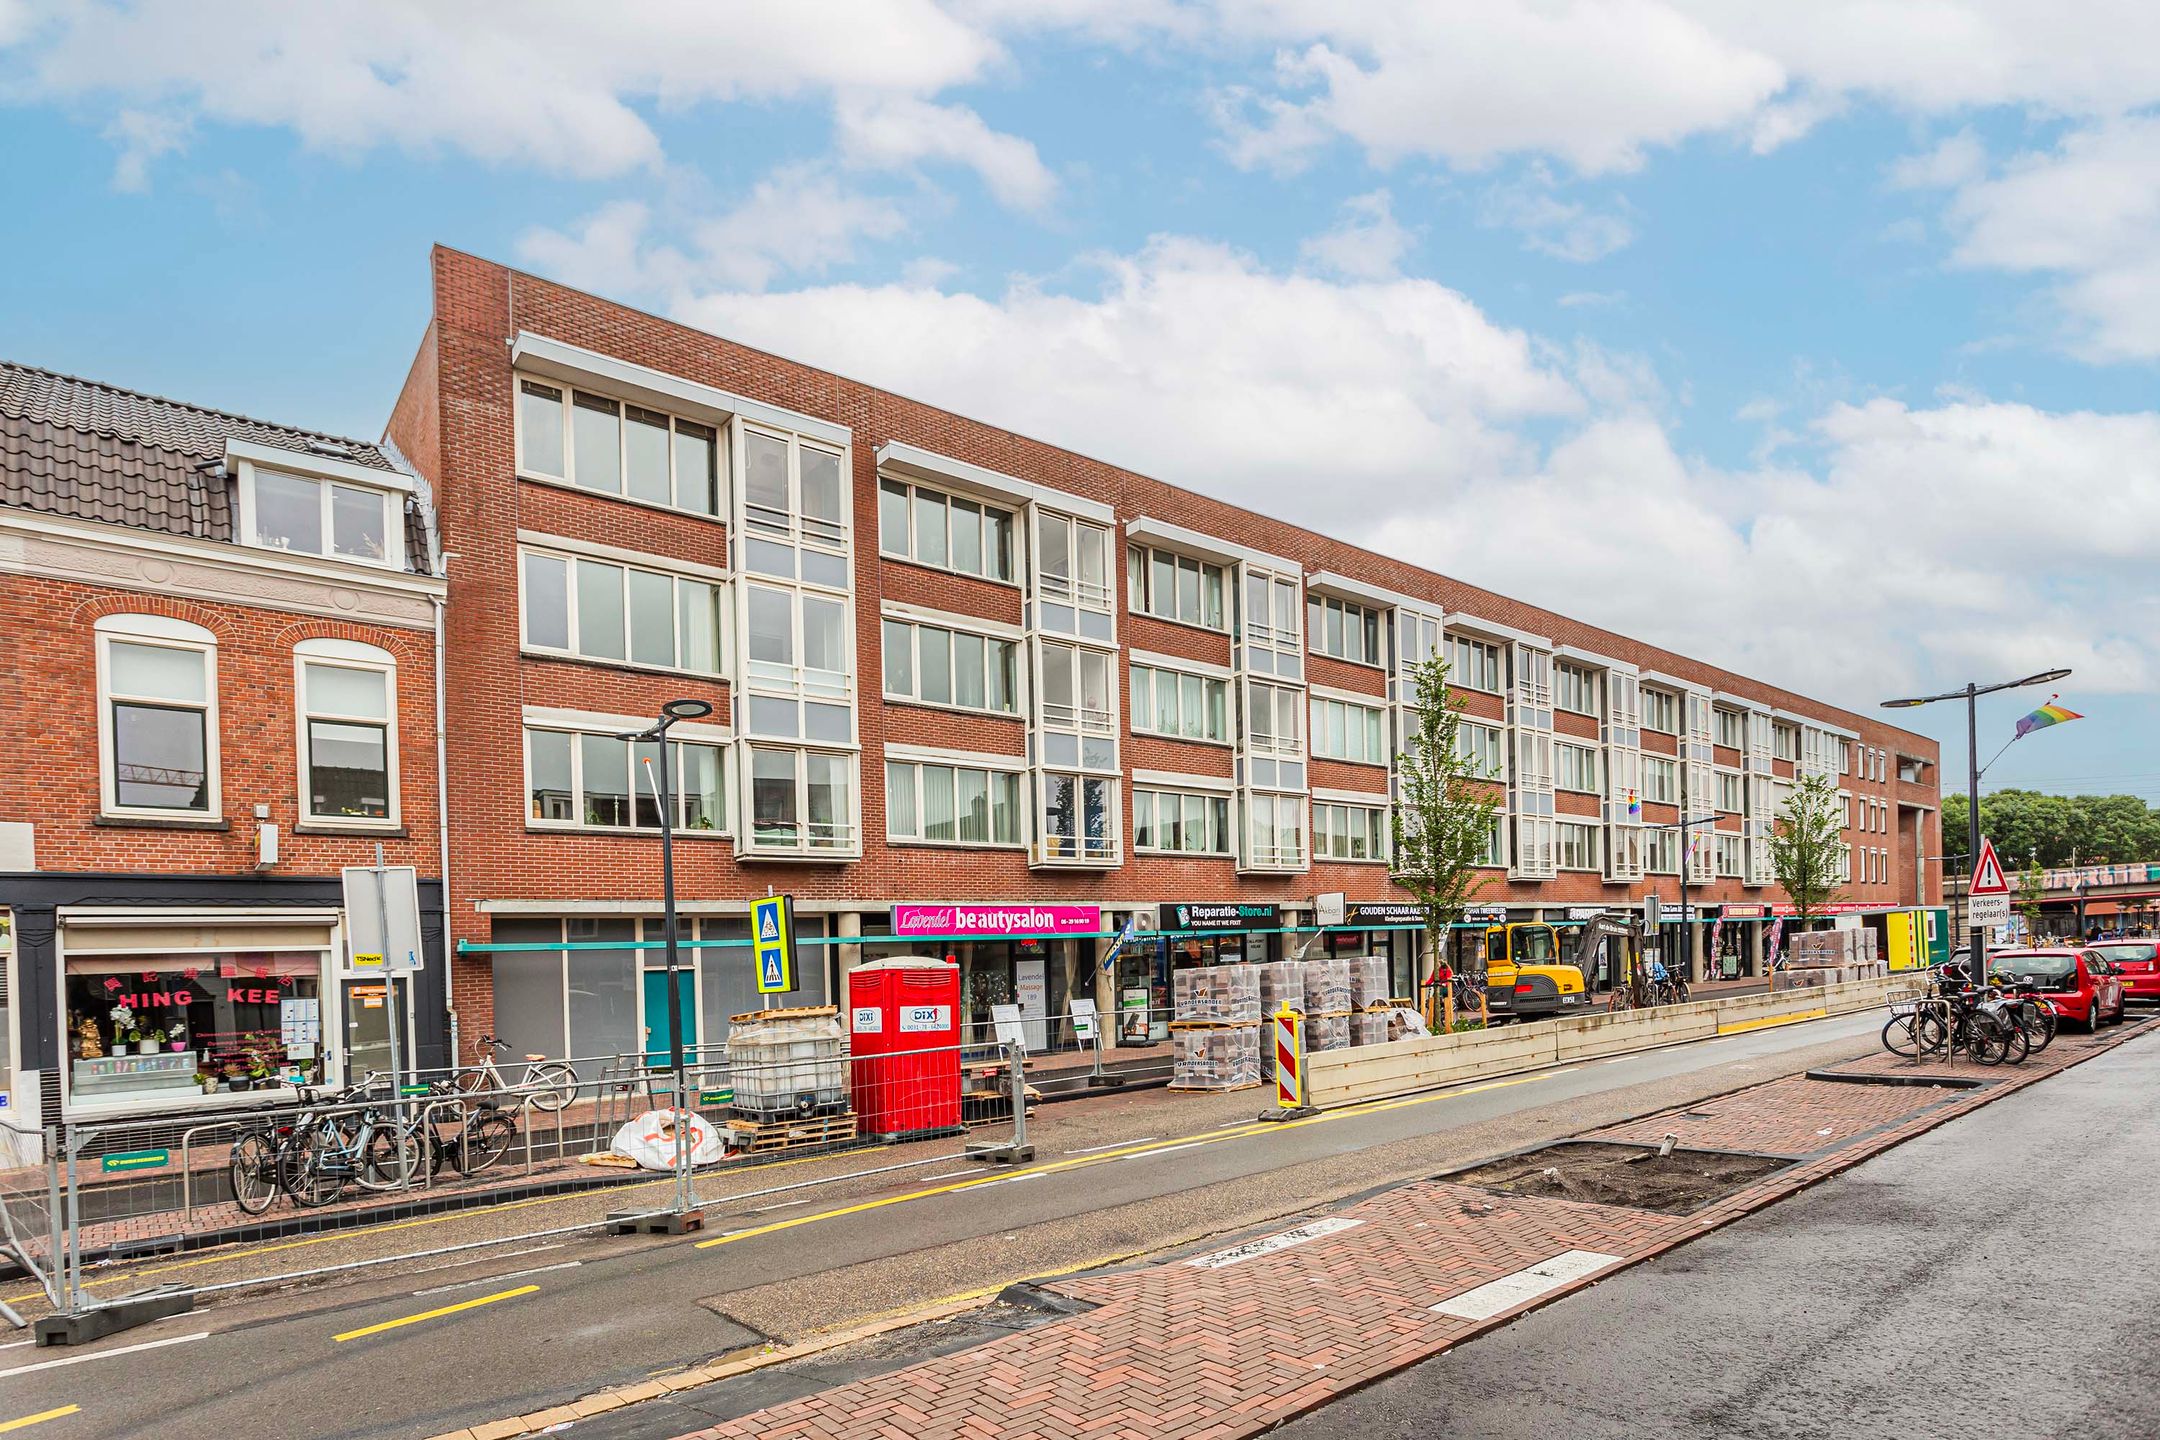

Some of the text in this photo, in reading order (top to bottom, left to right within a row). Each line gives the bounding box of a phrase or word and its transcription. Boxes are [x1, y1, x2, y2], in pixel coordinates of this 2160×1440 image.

[1972, 899, 2003, 908] Verkeers-
[1191, 905, 1272, 919] Reparatie-Store.nl
[1360, 906, 1386, 915] GOUDEN
[1386, 906, 1409, 915] SCHAAR
[1972, 908, 2008, 921] regelaar(s)
[899, 909, 952, 929] Lavendel
[955, 907, 1054, 933] beautysalon
[119, 988, 281, 1008] HING KEE
